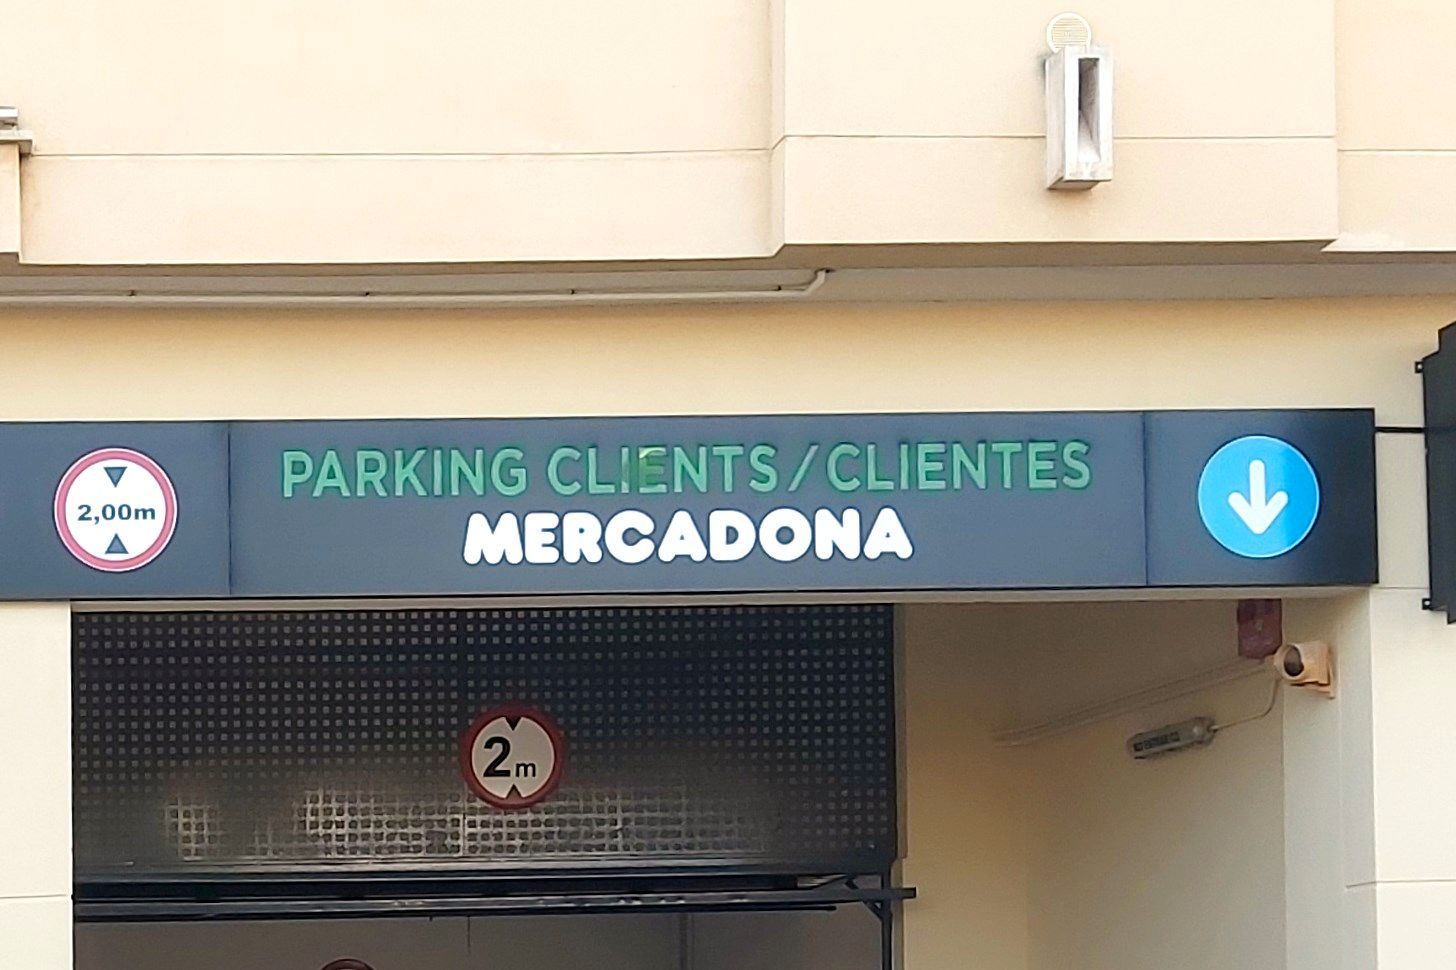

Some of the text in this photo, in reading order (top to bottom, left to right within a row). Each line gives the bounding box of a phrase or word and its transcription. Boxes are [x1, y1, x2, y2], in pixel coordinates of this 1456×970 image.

[281, 446, 529, 499] PARKING
[77, 503, 156, 525] 2,00m
[462, 507, 914, 565] MERCADONA
